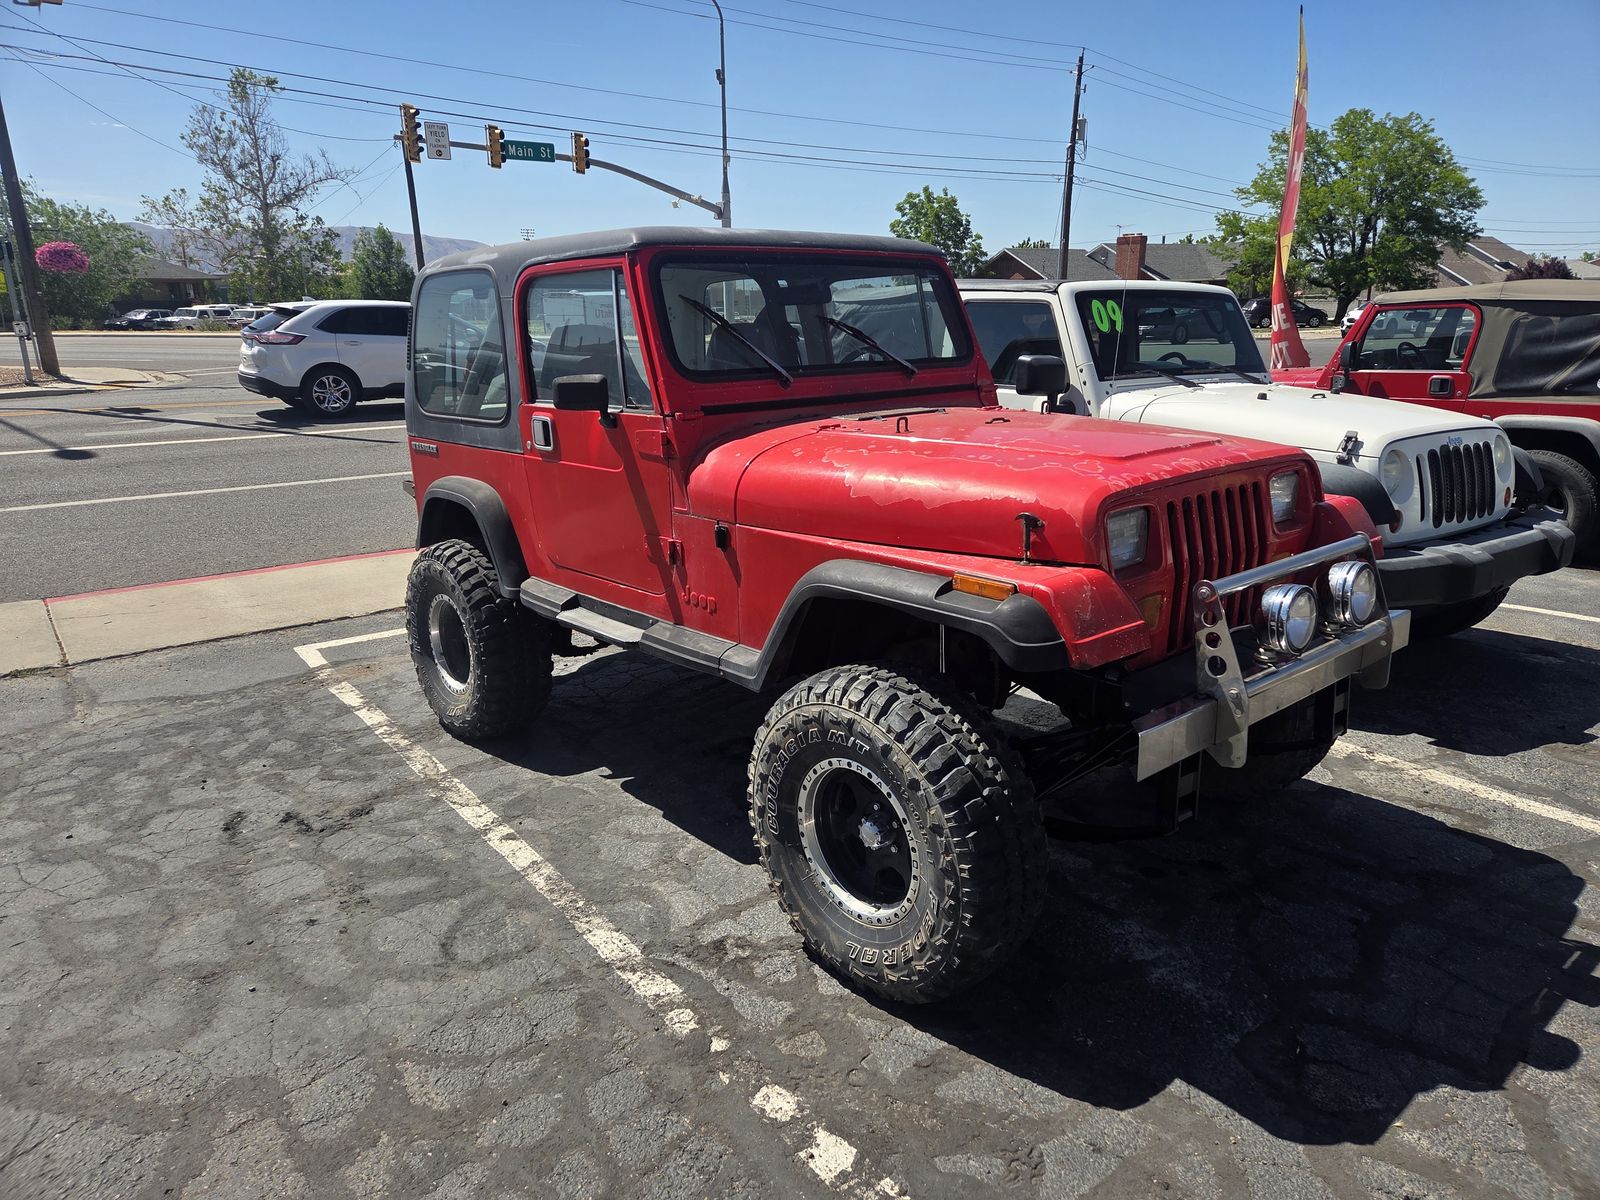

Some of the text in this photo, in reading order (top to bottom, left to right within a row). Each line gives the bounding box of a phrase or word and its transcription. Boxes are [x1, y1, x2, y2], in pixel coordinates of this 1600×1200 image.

[508, 144, 551, 158] Main St
[1091, 299, 1123, 332] 09
[682, 585, 717, 614] Jeep
[767, 727, 822, 835] COURAGIA
[846, 888, 939, 965] FEDERAL
